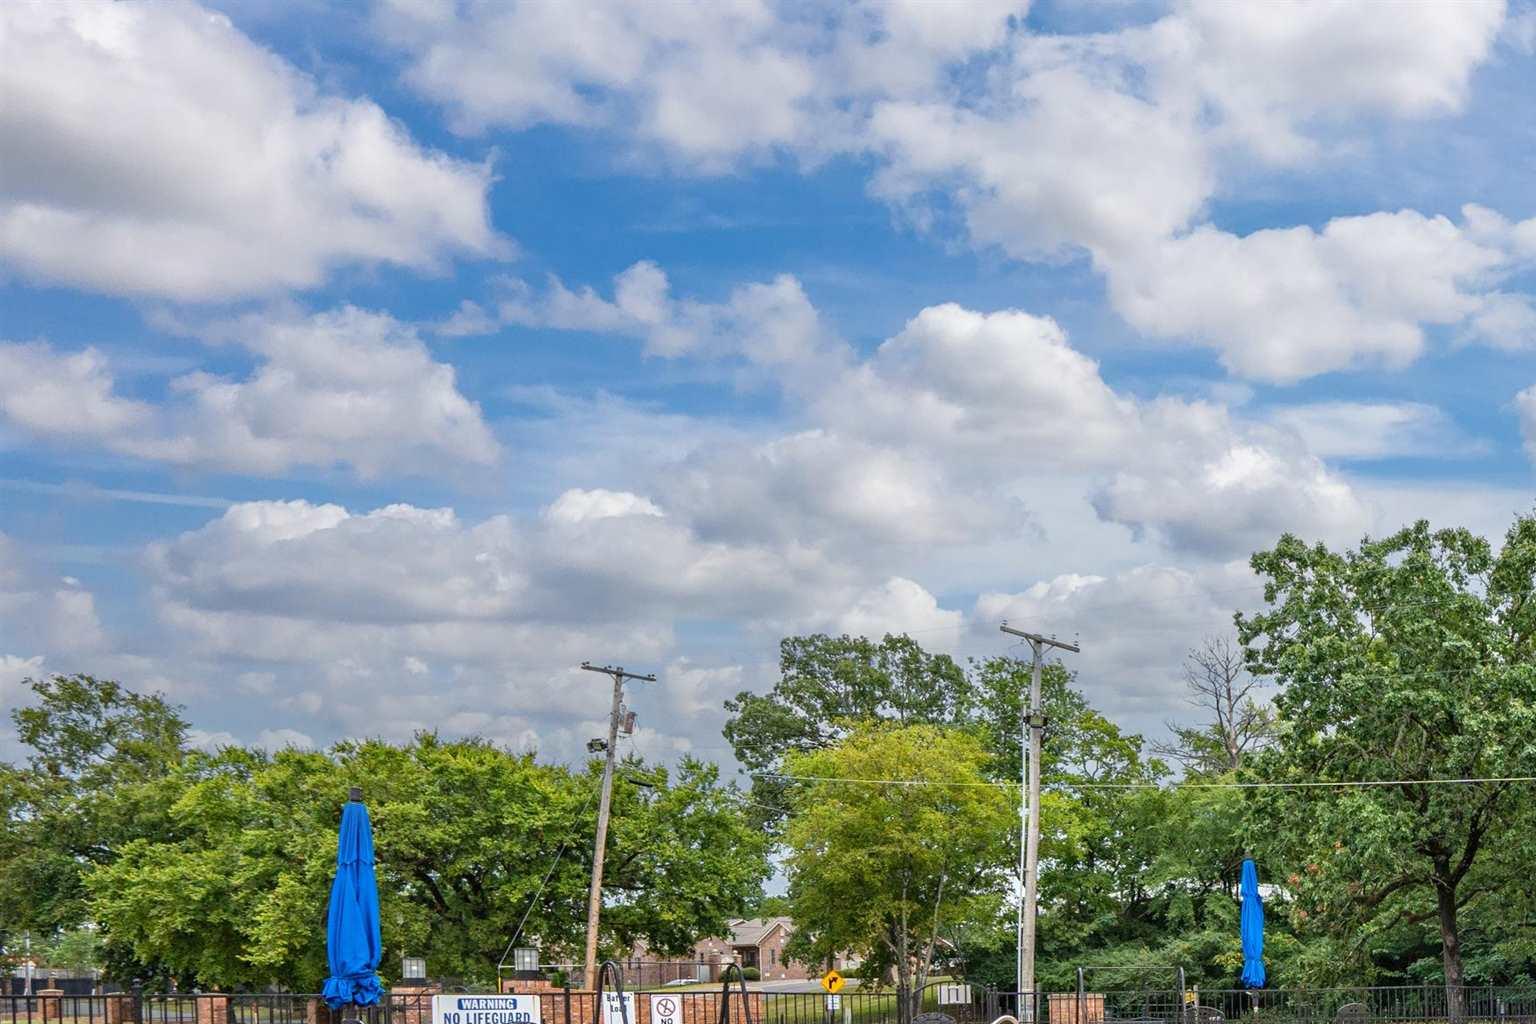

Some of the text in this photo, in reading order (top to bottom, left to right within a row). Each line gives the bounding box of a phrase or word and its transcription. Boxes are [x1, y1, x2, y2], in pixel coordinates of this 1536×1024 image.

[606, 993, 630, 1002] Bater
[461, 999, 514, 1010] WARNING
[443, 1012, 530, 1024] NO LIFEGUARD
